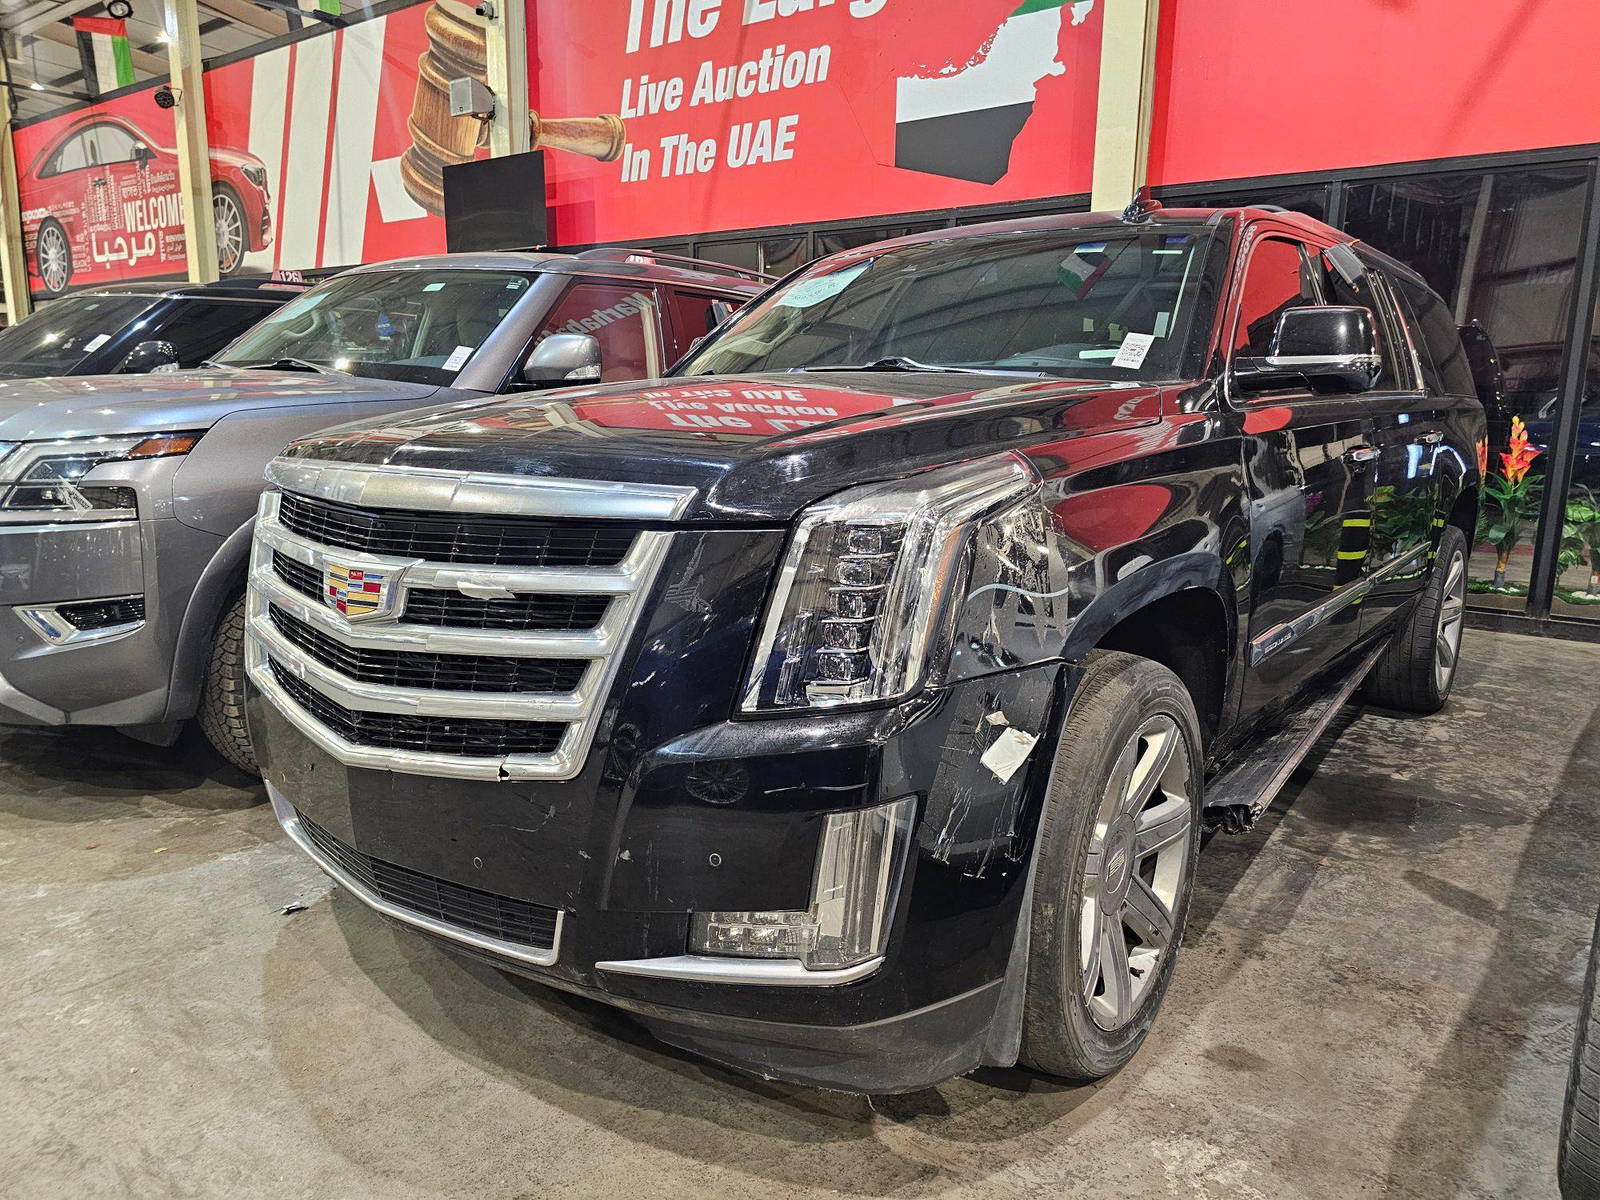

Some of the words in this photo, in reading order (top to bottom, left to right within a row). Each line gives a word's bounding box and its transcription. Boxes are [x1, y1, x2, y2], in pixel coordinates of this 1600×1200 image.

[620, 75, 684, 119] Live
[689, 43, 831, 107] Auction
[620, 143, 650, 183] In
[659, 133, 717, 178] The
[727, 114, 799, 169] UAE
[91, 231, 156, 270] مرحبا
